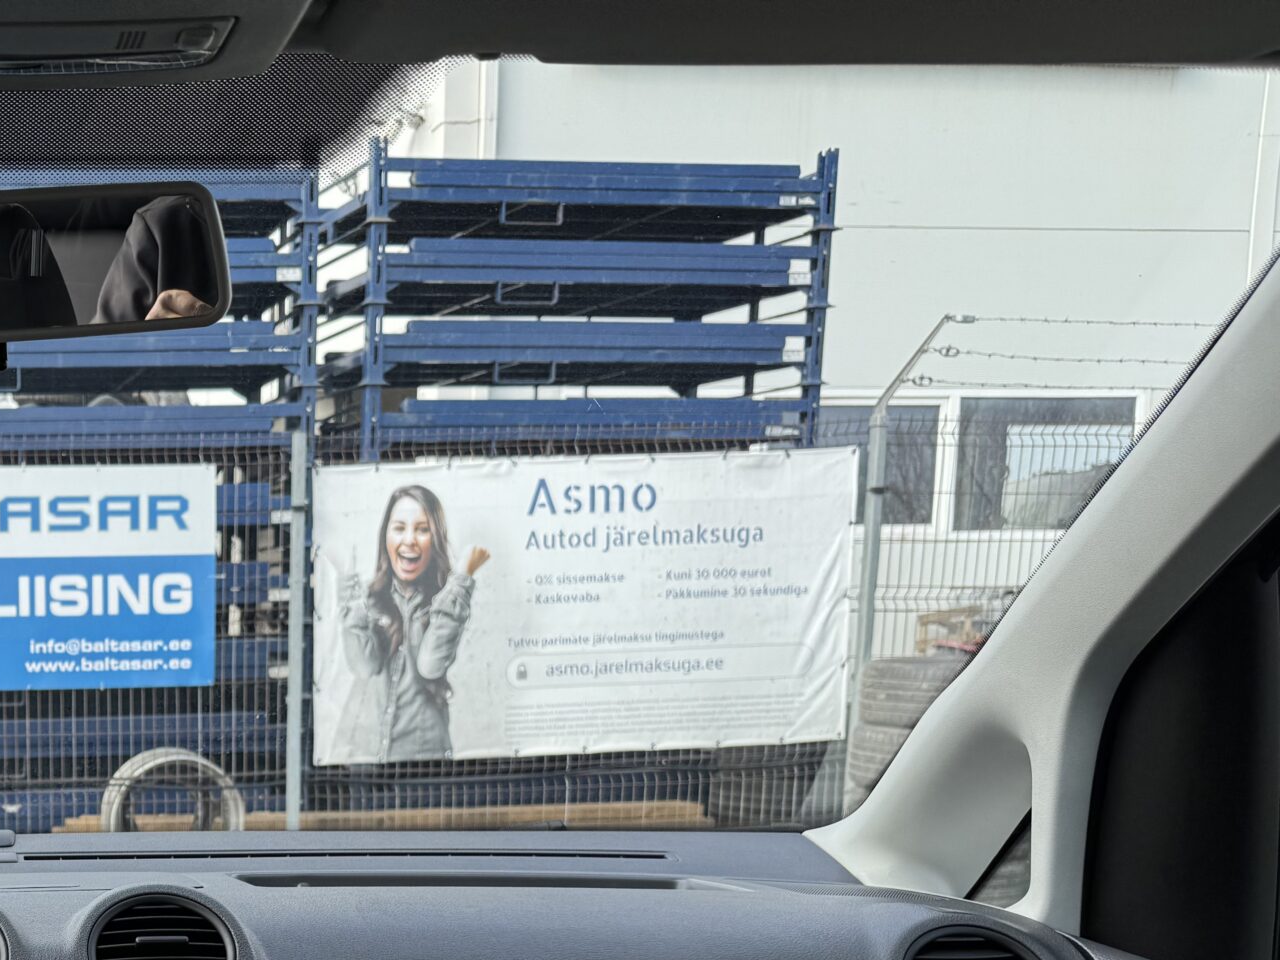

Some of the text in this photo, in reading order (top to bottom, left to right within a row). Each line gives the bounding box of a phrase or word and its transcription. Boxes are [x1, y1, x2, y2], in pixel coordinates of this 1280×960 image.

[527, 478, 658, 516] Asmo
[525, 523, 764, 553] Autod järelmaksuga
[556, 571, 625, 584] sissemakse
[665, 586, 729, 600] Pakkumine
[749, 583, 808, 599] sekundiga
[29, 637, 193, 655] info@baltasar.ee
[24, 656, 193, 673] www.baltasar.ee
